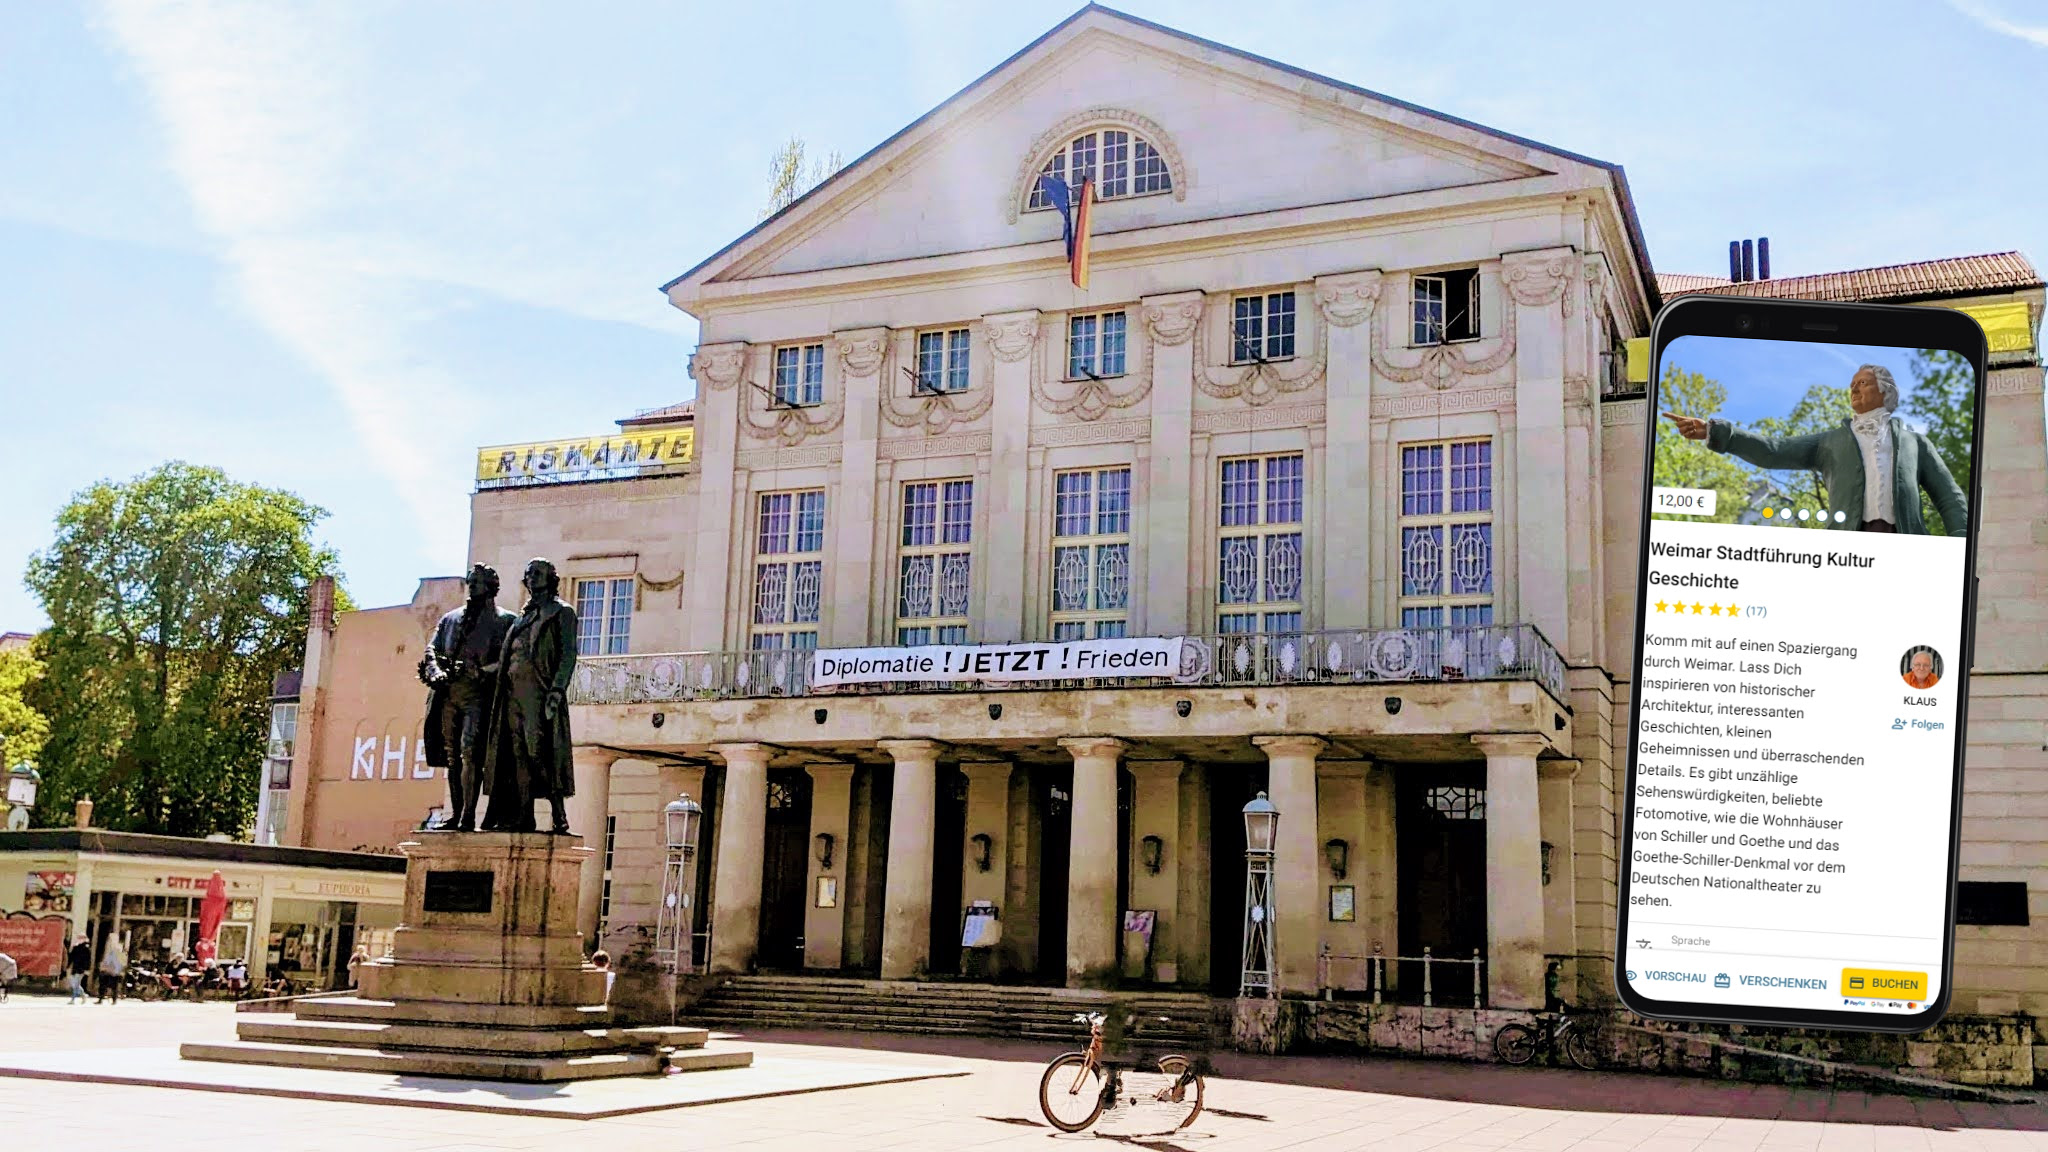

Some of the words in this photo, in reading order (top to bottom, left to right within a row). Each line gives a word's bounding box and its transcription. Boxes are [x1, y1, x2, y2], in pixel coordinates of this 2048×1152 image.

[496, 435, 691, 474] RISKANTE
[1657, 493, 1695, 509] 12,00
[1696, 496, 1705, 508] €
[1650, 541, 1713, 559] Weimar
[1716, 545, 1823, 569] Stadtführung
[1826, 551, 1876, 569] Kultur
[1648, 570, 1740, 590] Geschichte
[1745, 604, 1768, 618] (17)
[1644, 632, 1688, 648] Komm
[1691, 636, 1712, 649] mit
[1715, 637, 1737, 650] auf
[1739, 640, 1775, 653] einen
[1777, 640, 1858, 660] Spaziergang
[822, 655, 934, 679] Diplomatie
[942, 651, 951, 673] !
[958, 649, 1050, 673] JETZT
[1061, 647, 1069, 669] !
[1077, 648, 1168, 670] Frieden
[1643, 654, 1681, 669] durch
[1683, 657, 1736, 673] Weimar.
[1739, 660, 1770, 674] Lass
[1773, 662, 1802, 676] Dich
[1642, 676, 1710, 692] inspirieren
[1712, 683, 1737, 694] von
[1739, 681, 1816, 698] historischer
[1641, 699, 1714, 716] Architektur,
[1717, 703, 1805, 719] interessanten
[1903, 695, 1937, 707] KLAUS
[1640, 719, 1723, 738] Geschichten,
[1726, 724, 1772, 739] kleinen
[1911, 718, 1945, 732] Folgen
[1639, 741, 1730, 759] Geheimnissen
[1733, 747, 1758, 760] und
[1761, 748, 1865, 766] überraschenden
[1637, 763, 1685, 778] Details.
[1689, 766, 1705, 779] Es
[1708, 767, 1733, 783] gibt
[1736, 770, 1799, 785] unzählige
[1636, 785, 1769, 806] Sehenswürdigkeiten,
[1771, 792, 1823, 808] beliebte
[1635, 806, 1711, 824] Fotomotive,
[1713, 811, 1737, 824] wie
[1739, 812, 1760, 826] die
[1762, 813, 1844, 830] Wohnhäuser
[1633, 830, 1658, 841] von
[1660, 829, 1709, 844] Schiller
[1711, 833, 1736, 846] und
[1738, 833, 1786, 849] Goethe
[1788, 837, 1813, 850] und
[1815, 838, 1840, 852] das
[1632, 849, 1791, 871] Goethe-Schiller-Denkmal
[1793, 861, 1815, 872] vor
[1817, 860, 1846, 874] dem
[167, 876, 192, 889] CITY
[1631, 871, 1700, 887] Deutschen
[1703, 875, 1803, 894] Nationaltheater
[1806, 884, 1822, 895] zu
[1630, 893, 1673, 908] sehen.
[1671, 934, 1711, 948] Sprache
[1644, 970, 1707, 983] VORSCHAU
[1739, 974, 1828, 990] VERSCHENKEN
[1872, 978, 1919, 990] BUCHEN
